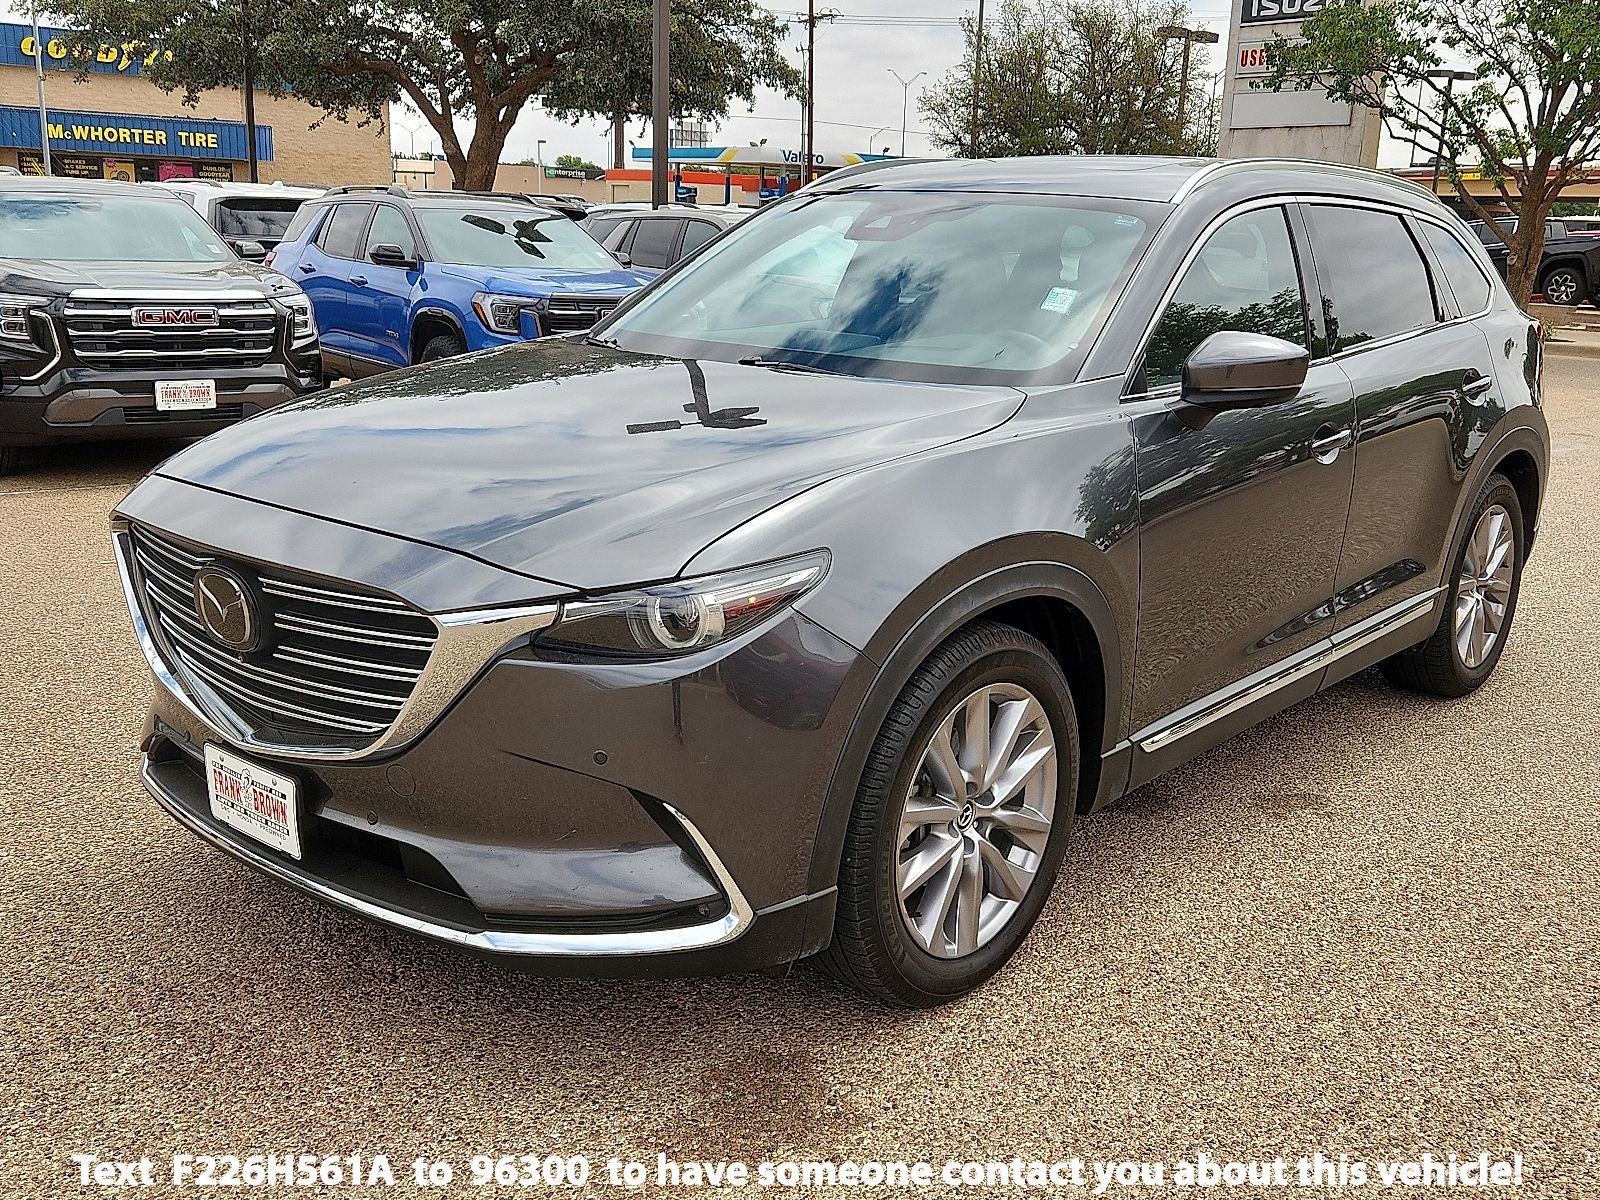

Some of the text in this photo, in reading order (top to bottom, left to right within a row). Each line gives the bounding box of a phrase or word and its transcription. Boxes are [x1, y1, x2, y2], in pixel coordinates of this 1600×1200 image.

[1251, 0, 1344, 17] ISUZ
[1240, 48, 1266, 68] USE
[47, 123, 218, 148] McWHORTER TIRE
[140, 310, 215, 324] GMC
[213, 768, 243, 803] FRANK
[252, 788, 288, 827] BROWN
